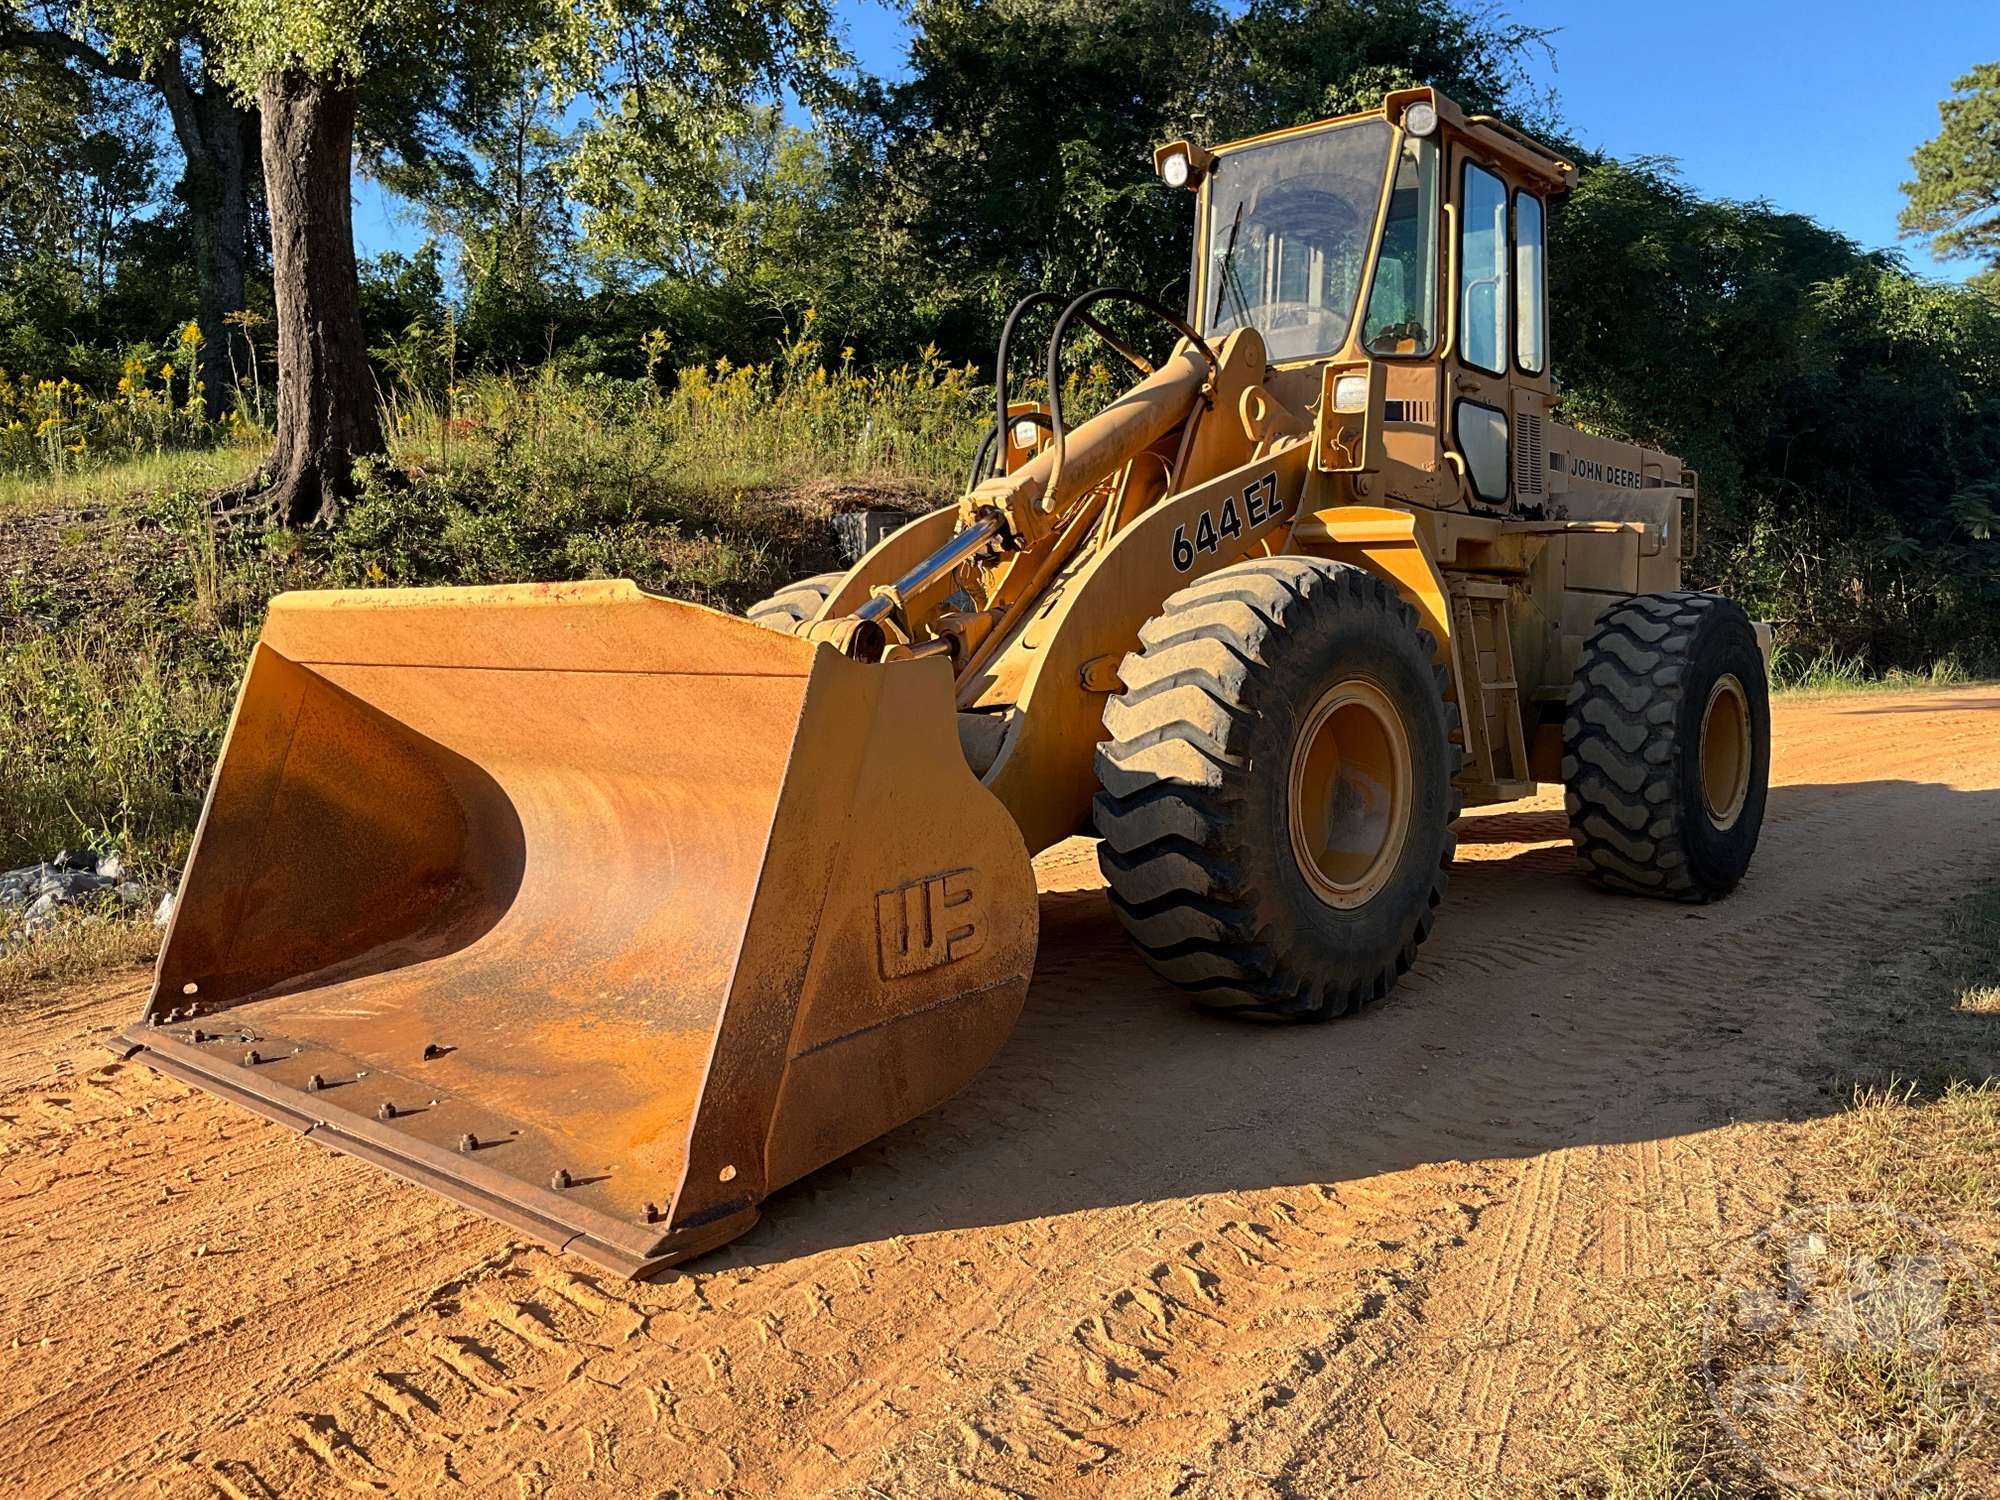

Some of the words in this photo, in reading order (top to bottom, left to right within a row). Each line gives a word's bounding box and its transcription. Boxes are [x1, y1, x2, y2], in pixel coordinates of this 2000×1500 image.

[1571, 458, 1602, 482] JOHN
[1606, 465, 1640, 489] DEERE
[1172, 496, 1242, 573] 644
[1242, 470, 1284, 529] EZ
